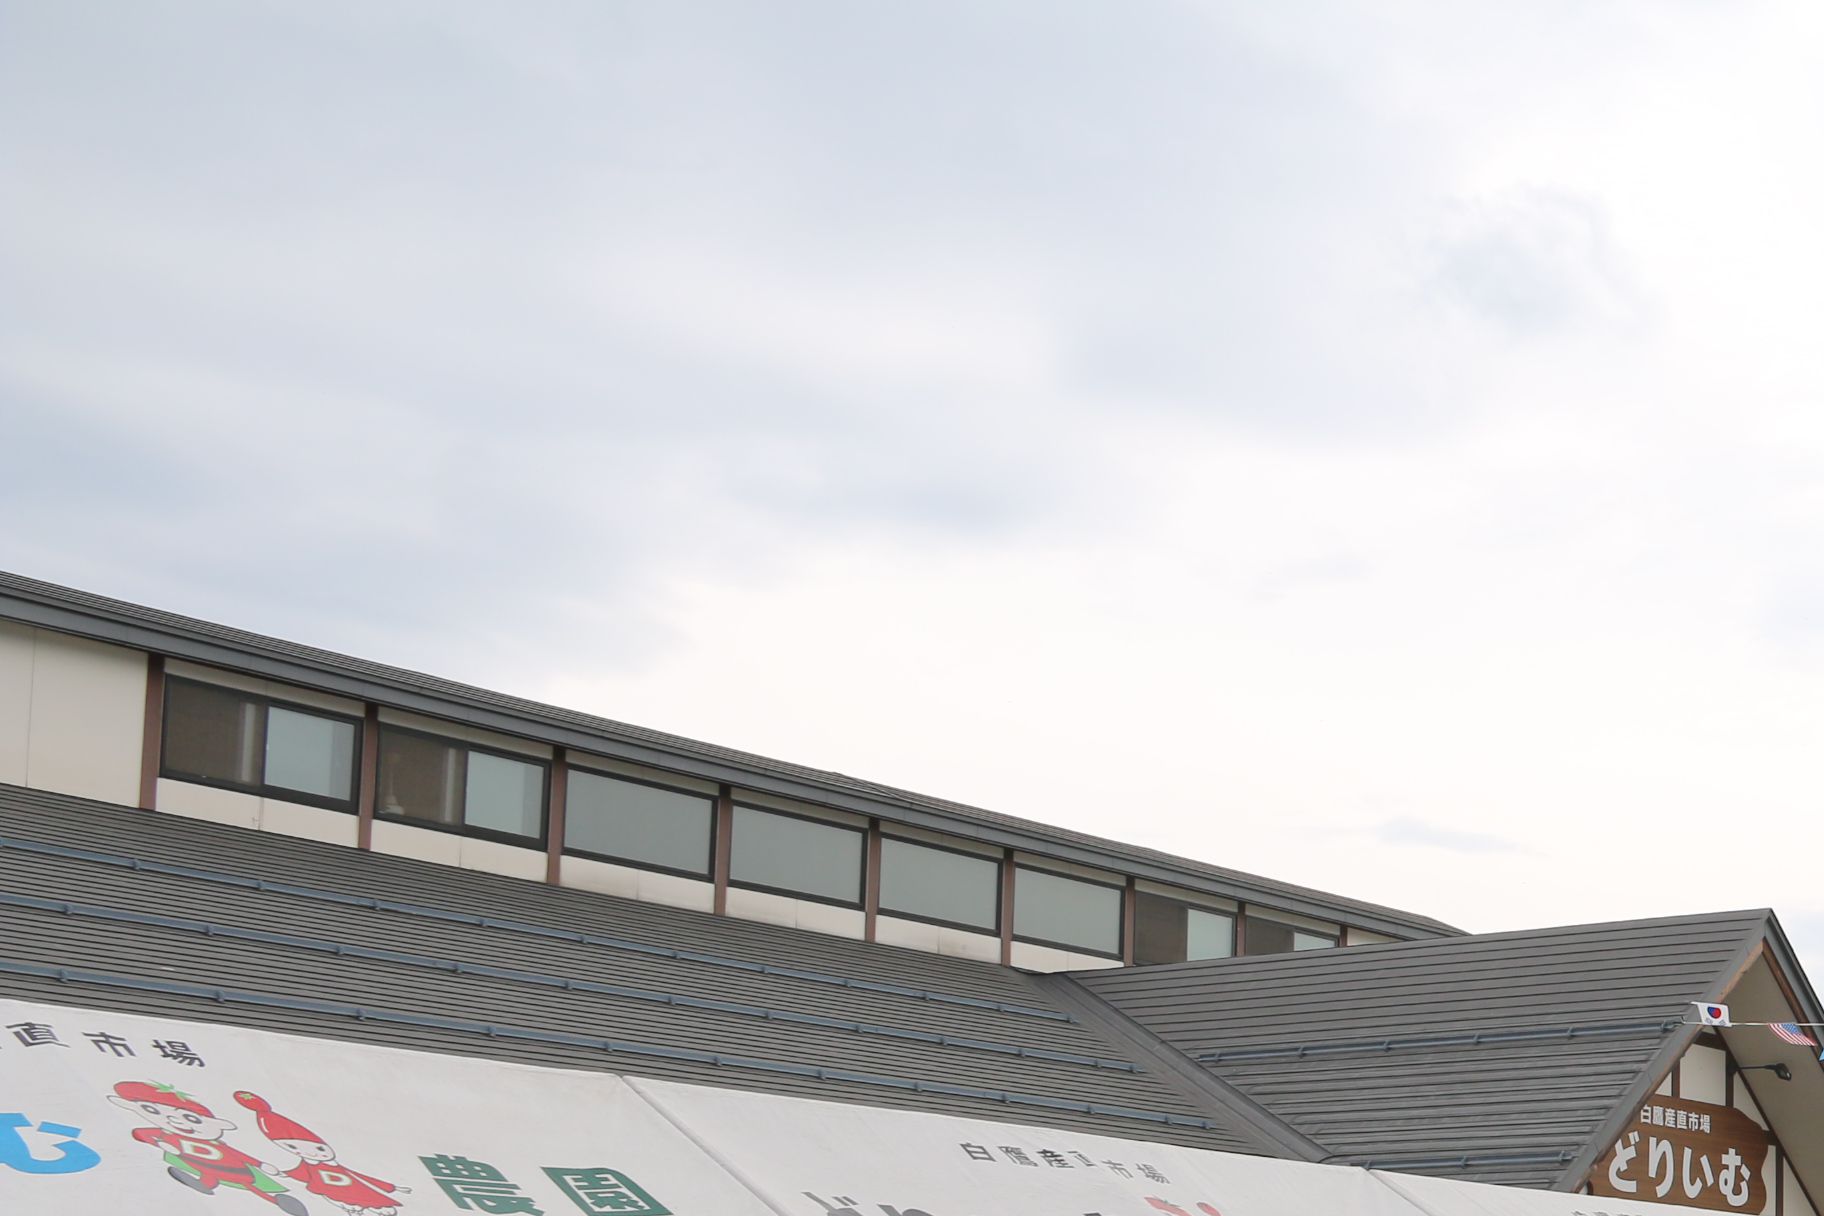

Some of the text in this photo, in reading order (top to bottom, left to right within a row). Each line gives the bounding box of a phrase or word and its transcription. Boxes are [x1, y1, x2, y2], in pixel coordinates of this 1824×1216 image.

[0, 1021, 206, 1068] 直市場
[1640, 1104, 1711, 1134] 白鷹産直市場
[179, 1139, 223, 1161] D
[319, 1169, 353, 1187] D
[1608, 1130, 1751, 1207] どりいむ
